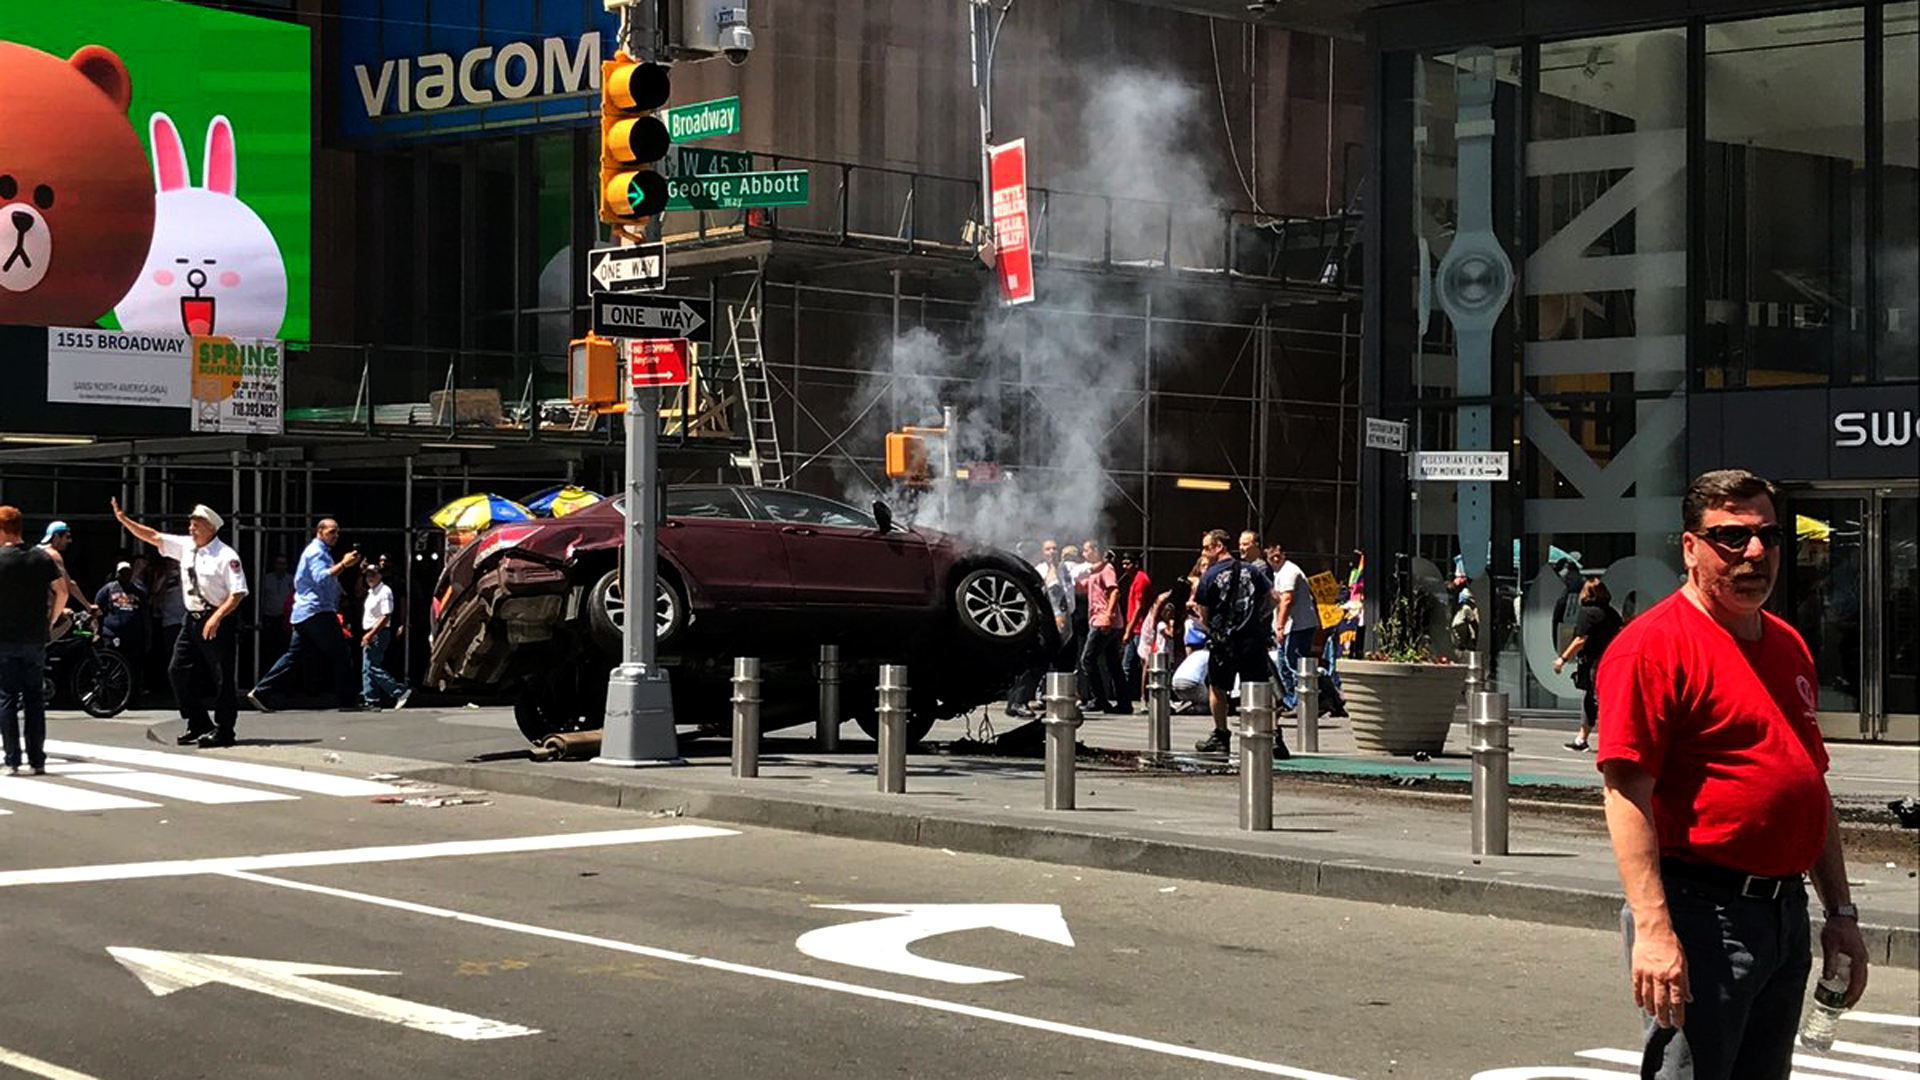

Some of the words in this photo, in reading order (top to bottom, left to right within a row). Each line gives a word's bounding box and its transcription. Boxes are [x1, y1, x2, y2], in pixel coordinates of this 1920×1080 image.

[672, 106, 735, 137] Broadway
[683, 151, 700, 176] W
[708, 155, 730, 174] 45
[738, 158, 749, 172] St
[668, 180, 731, 200] George
[739, 175, 800, 195] Abbott
[600, 263, 621, 280] ONE
[632, 259, 656, 277] WAY
[611, 307, 645, 325] ONE
[660, 311, 695, 328] WAY
[57, 332, 93, 348] 1515
[99, 334, 184, 352] BROADWAY
[200, 343, 278, 367] SPRING
